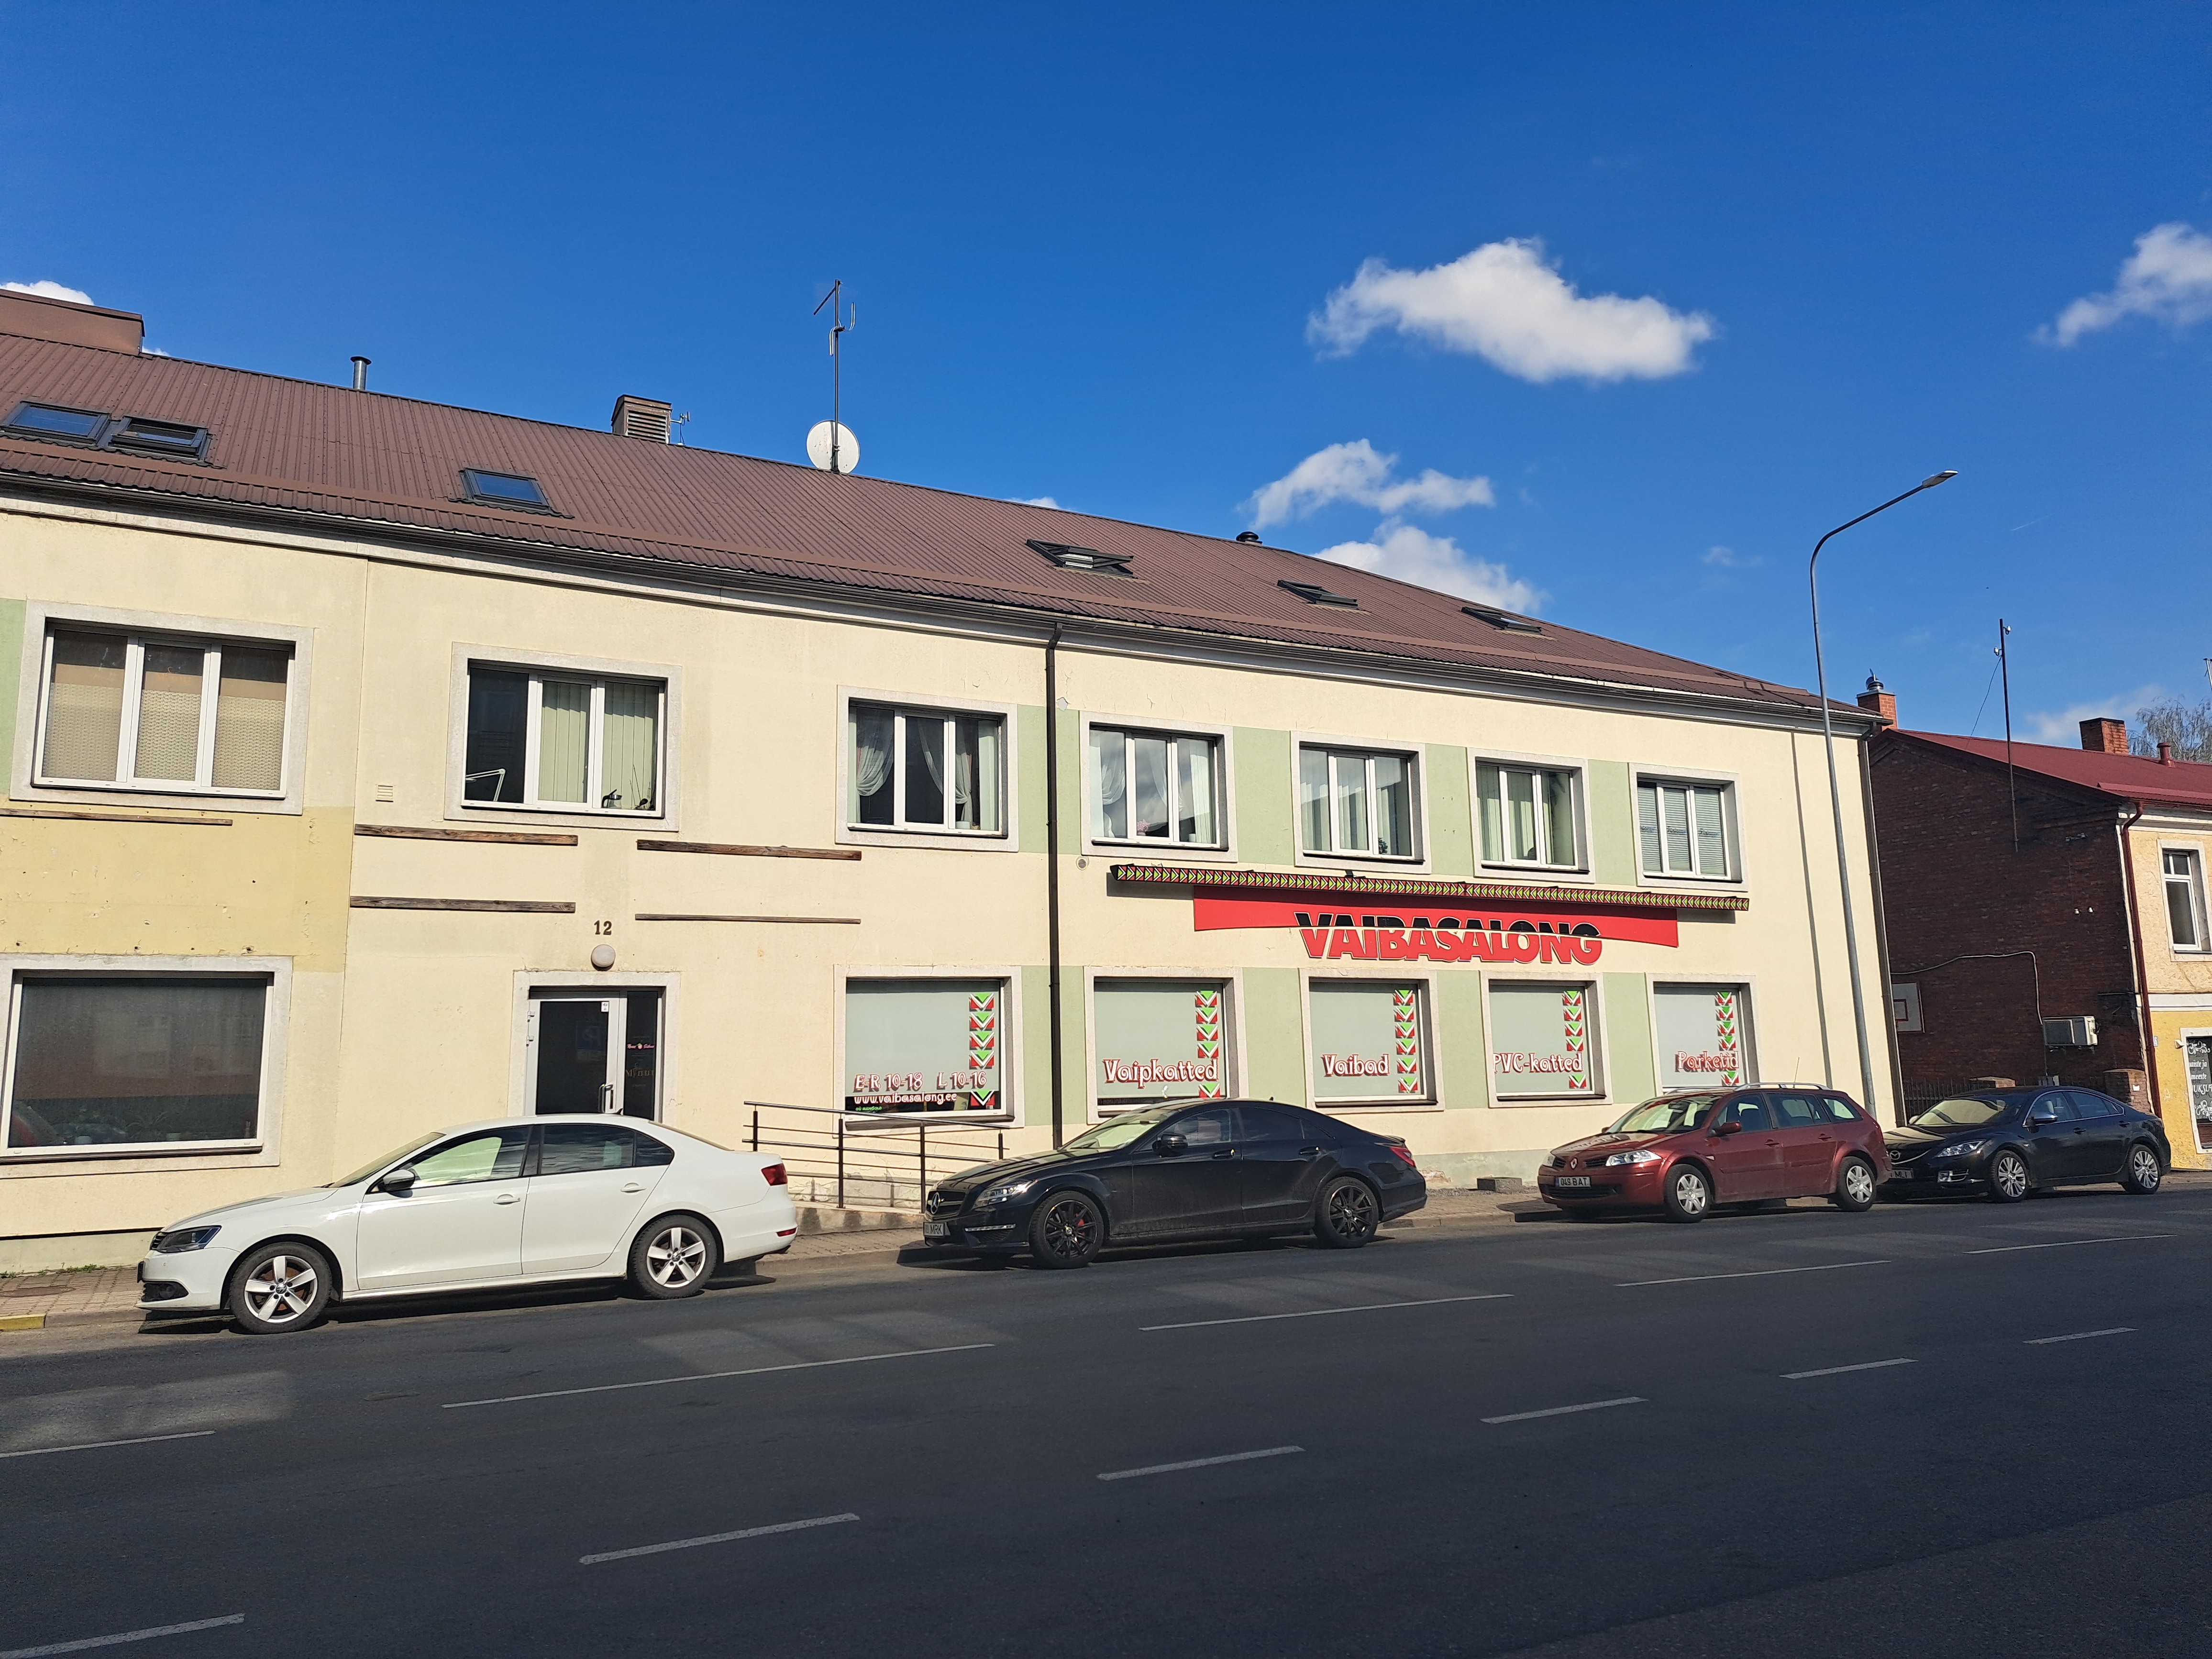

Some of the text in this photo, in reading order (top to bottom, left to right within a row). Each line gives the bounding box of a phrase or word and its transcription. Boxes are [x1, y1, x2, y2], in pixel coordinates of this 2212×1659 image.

[594, 920, 612, 935] 12
[1294, 912, 1603, 965] VAIBASALONG
[1322, 1054, 1390, 1076] Vaibad
[1493, 1052, 1583, 1073] PVC-katted
[1676, 1051, 1739, 1071] Parketid
[854, 1072, 923, 1091] E-R 10-18
[938, 1071, 987, 1088] L 10-16
[1103, 1059, 1219, 1088] Vaipkatted
[854, 1091, 957, 1105] www.vaibasalong.ee
[1572, 1177, 1587, 1185] BAT
